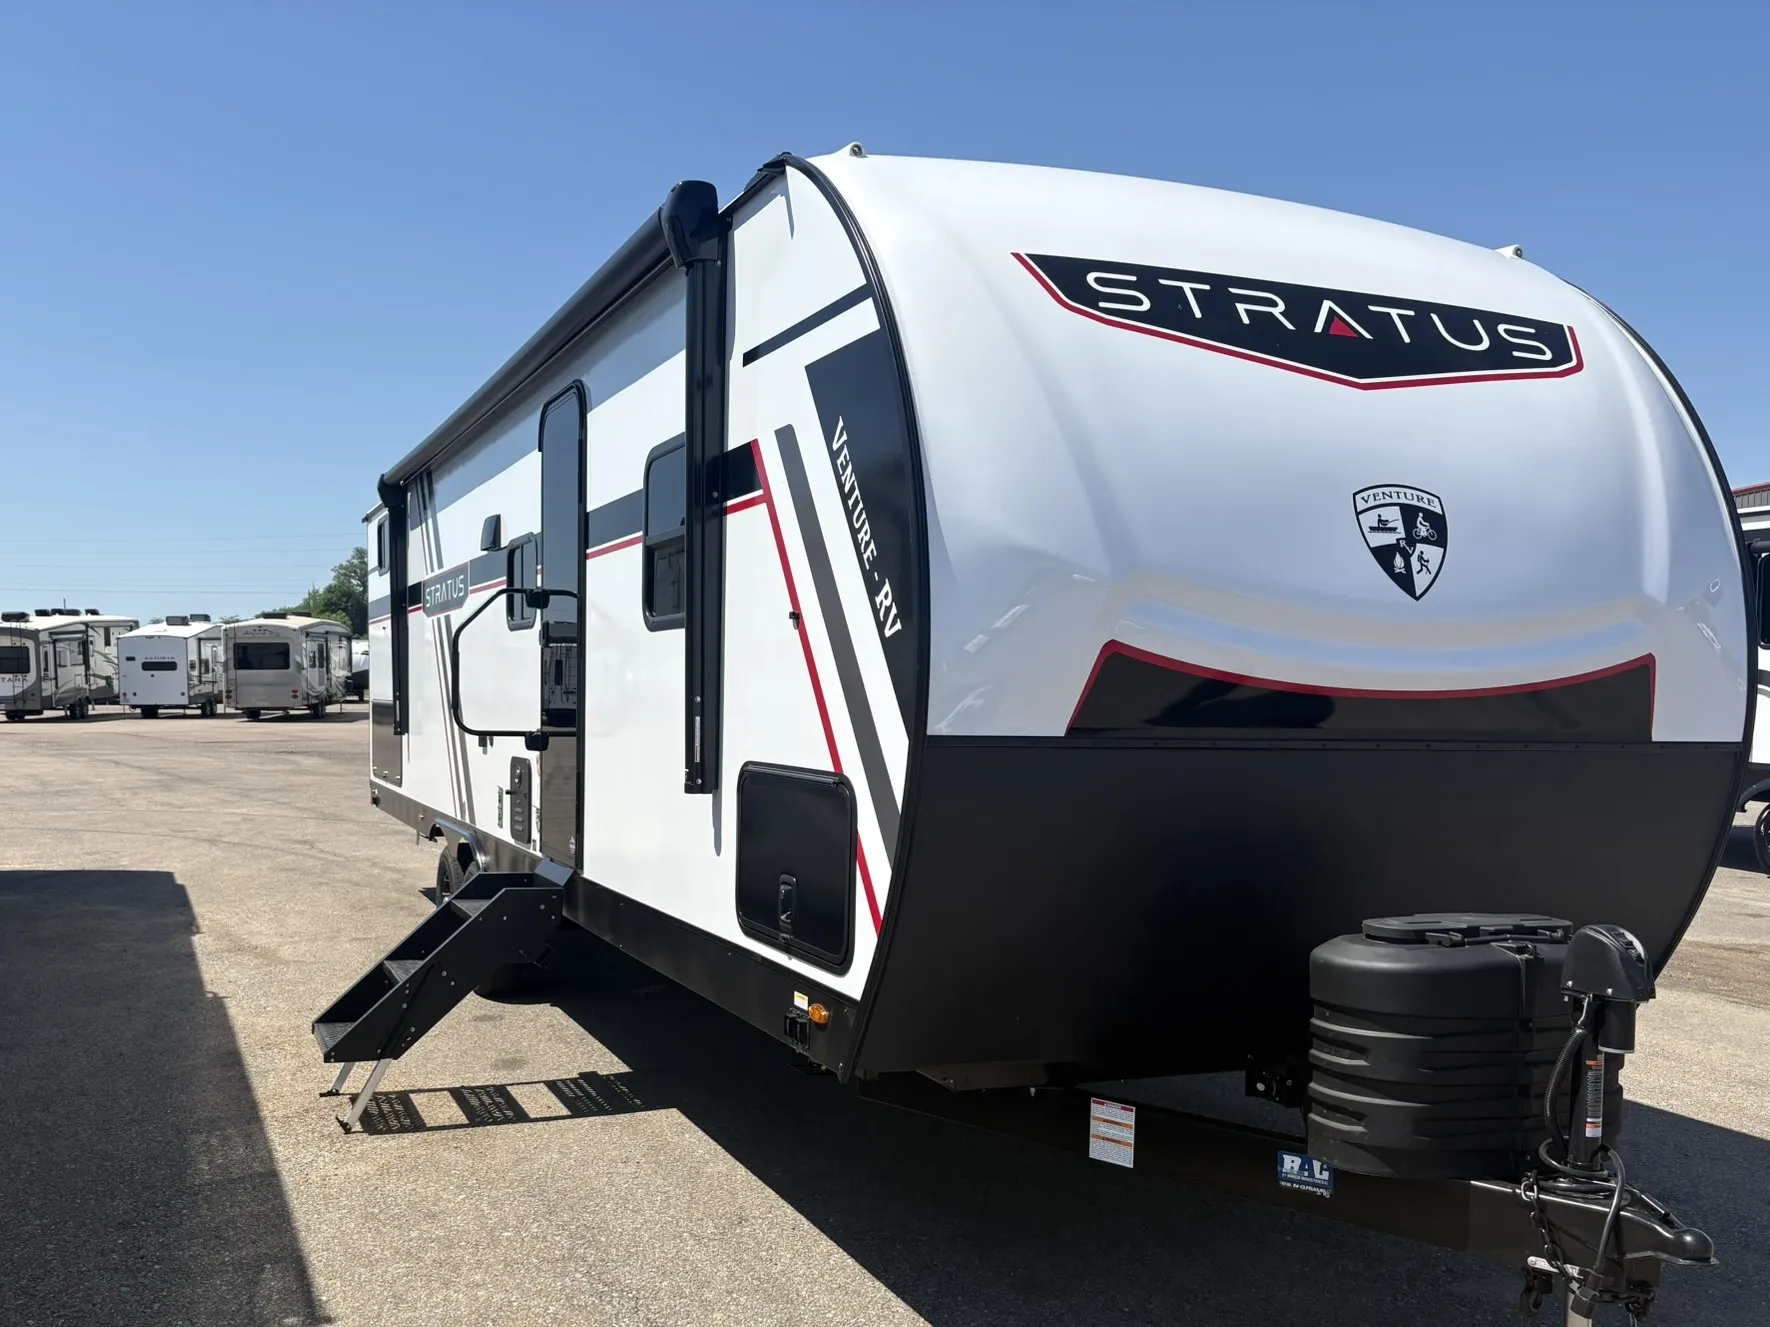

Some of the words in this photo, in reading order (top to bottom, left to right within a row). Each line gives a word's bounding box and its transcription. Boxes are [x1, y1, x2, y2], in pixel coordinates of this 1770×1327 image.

[1086, 271, 1552, 361] STRATUS
[832, 415, 878, 570] VENTURE
[875, 578, 902, 638] RV
[1360, 490, 1437, 509] VENTURE
[425, 574, 465, 608] STRATUS
